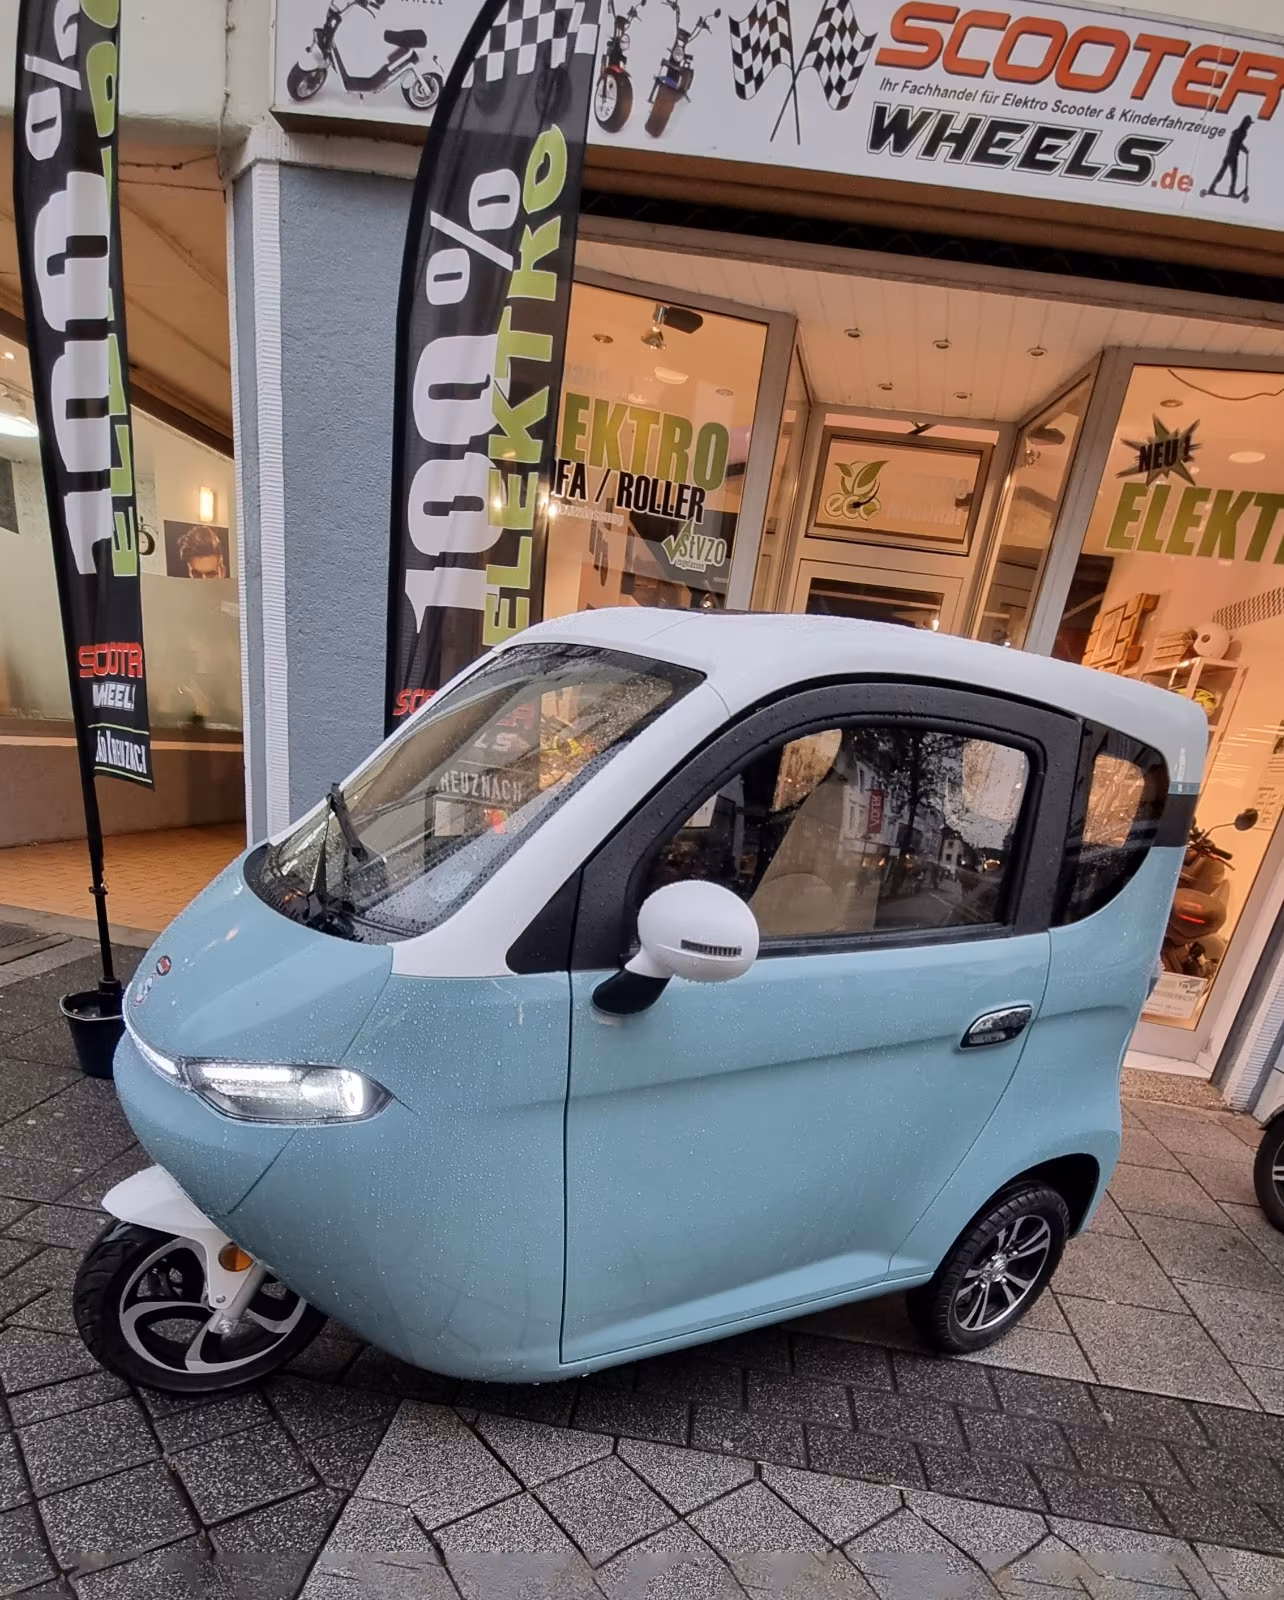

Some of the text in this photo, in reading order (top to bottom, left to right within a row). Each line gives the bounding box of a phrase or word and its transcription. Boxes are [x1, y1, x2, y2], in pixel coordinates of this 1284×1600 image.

[875, 1, 1284, 121] SCOOTER
[879, 77, 1226, 139] Ihr Fachhandel für Elektro Scooter & Kinderfahrzeuge
[551, 457, 589, 502] FA
[616, 471, 706, 524] ROLLER
[679, 532, 726, 565] StVZO
[1105, 482, 1284, 565] ELEKT
[92, 681, 136, 711] WHEEL
[436, 769, 523, 802] REUZNACH
